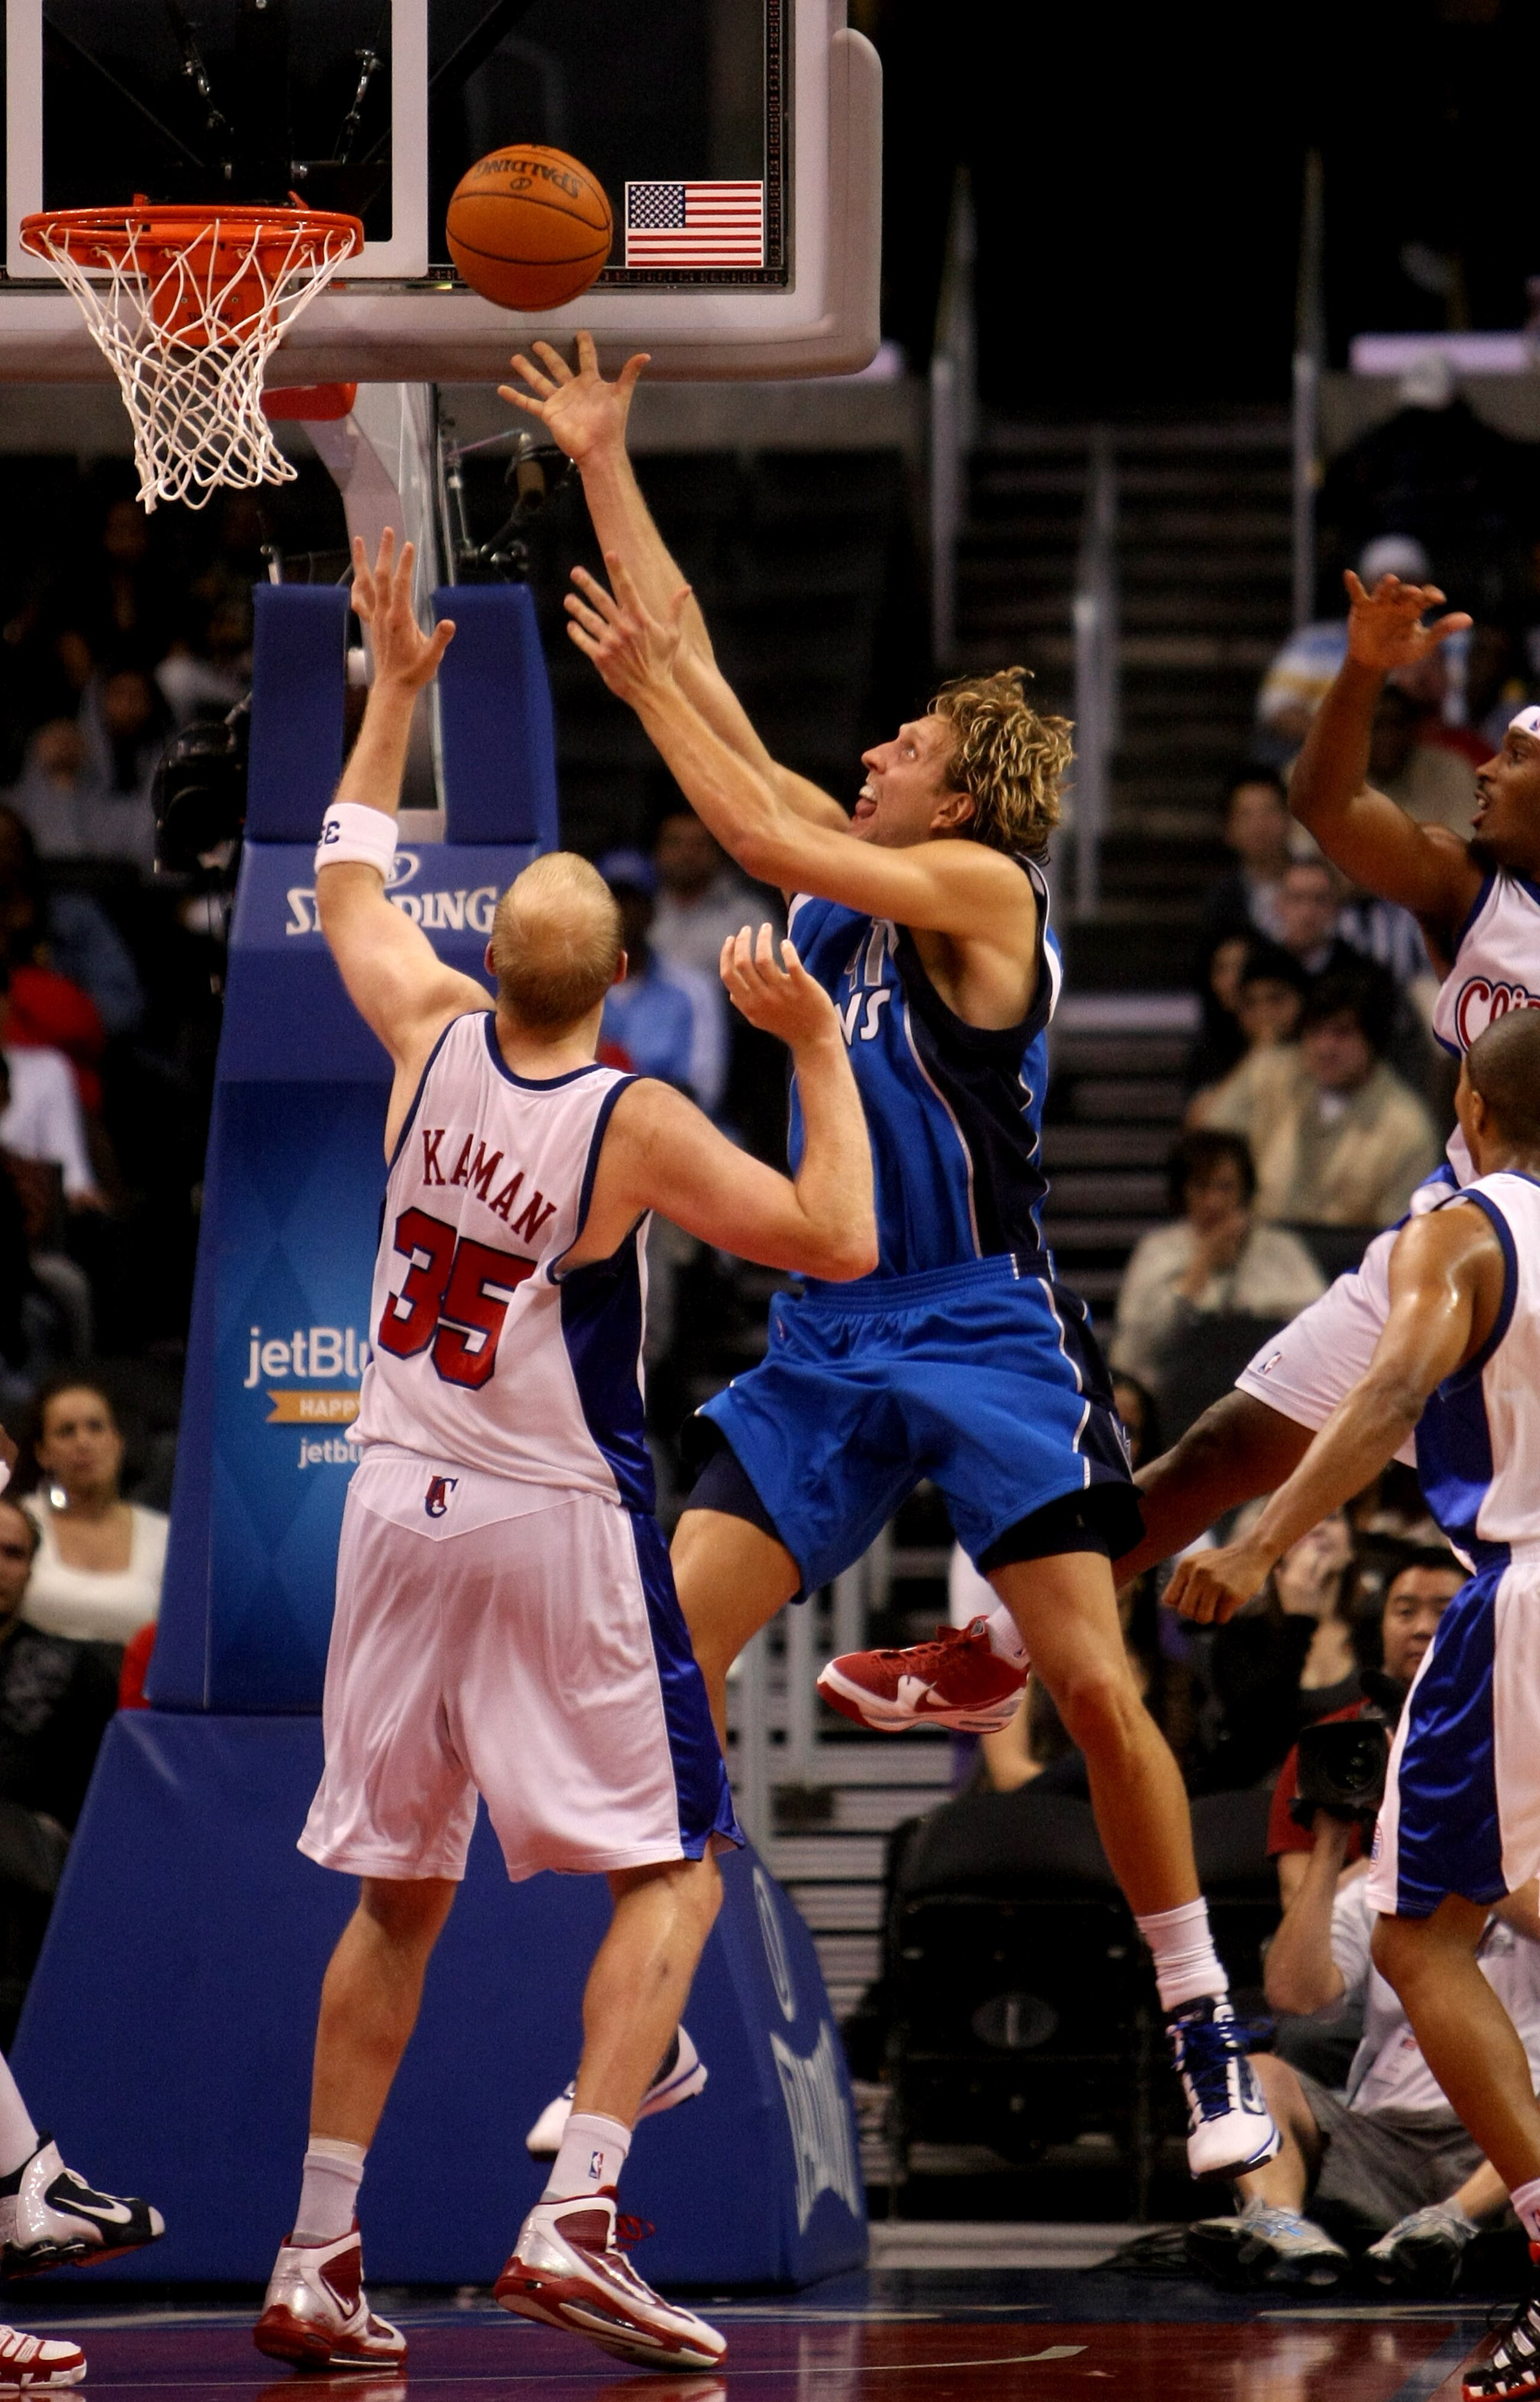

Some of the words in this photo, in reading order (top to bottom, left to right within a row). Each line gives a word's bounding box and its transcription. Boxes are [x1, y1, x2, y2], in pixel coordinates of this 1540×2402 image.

[286, 886, 497, 936] SDING
[422, 1129, 556, 1244] KAMAN
[378, 1206, 540, 1391] 35
[297, 1437, 362, 1469] jetbl
